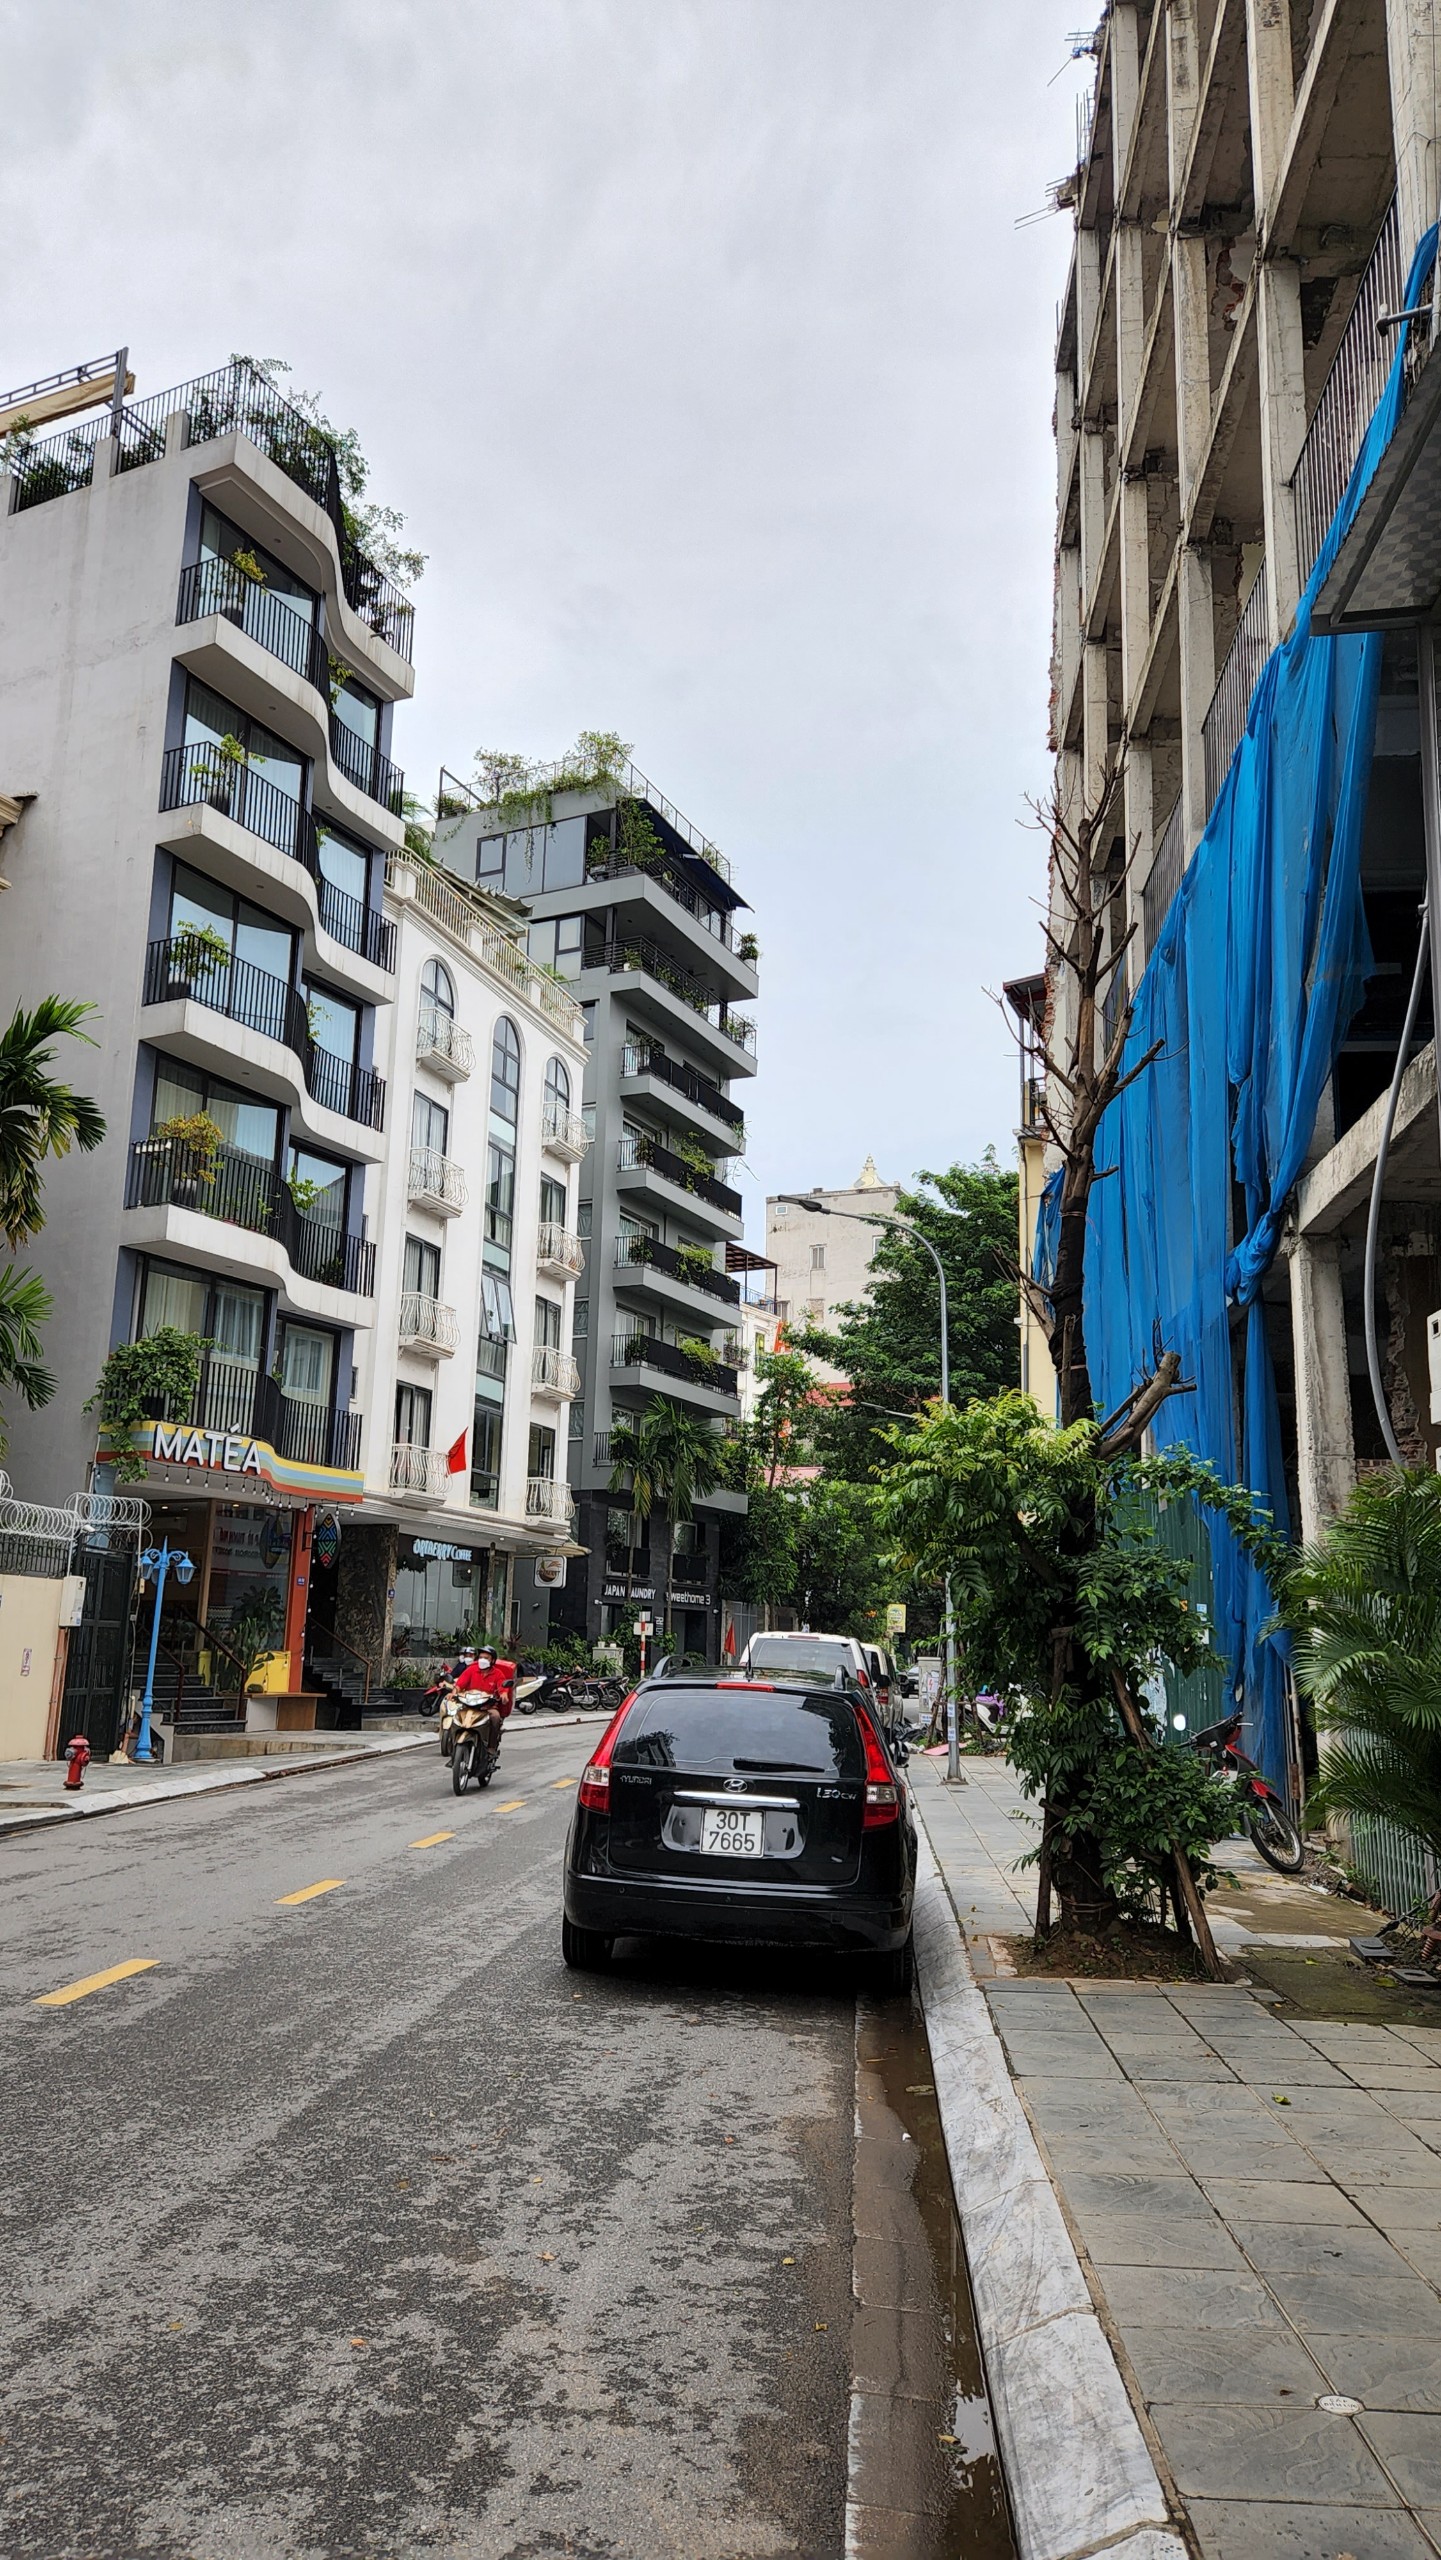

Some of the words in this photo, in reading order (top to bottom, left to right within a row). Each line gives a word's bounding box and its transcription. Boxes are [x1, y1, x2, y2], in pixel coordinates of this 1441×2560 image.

[154, 1423, 261, 1475] MATÉA
[604, 1584, 626, 1597] JAPAN
[629, 1587, 656, 1600] AUNDRY
[705, 1594, 711, 1605] 3
[716, 1811, 750, 1831] 30T
[709, 1832, 755, 1852] 7665
